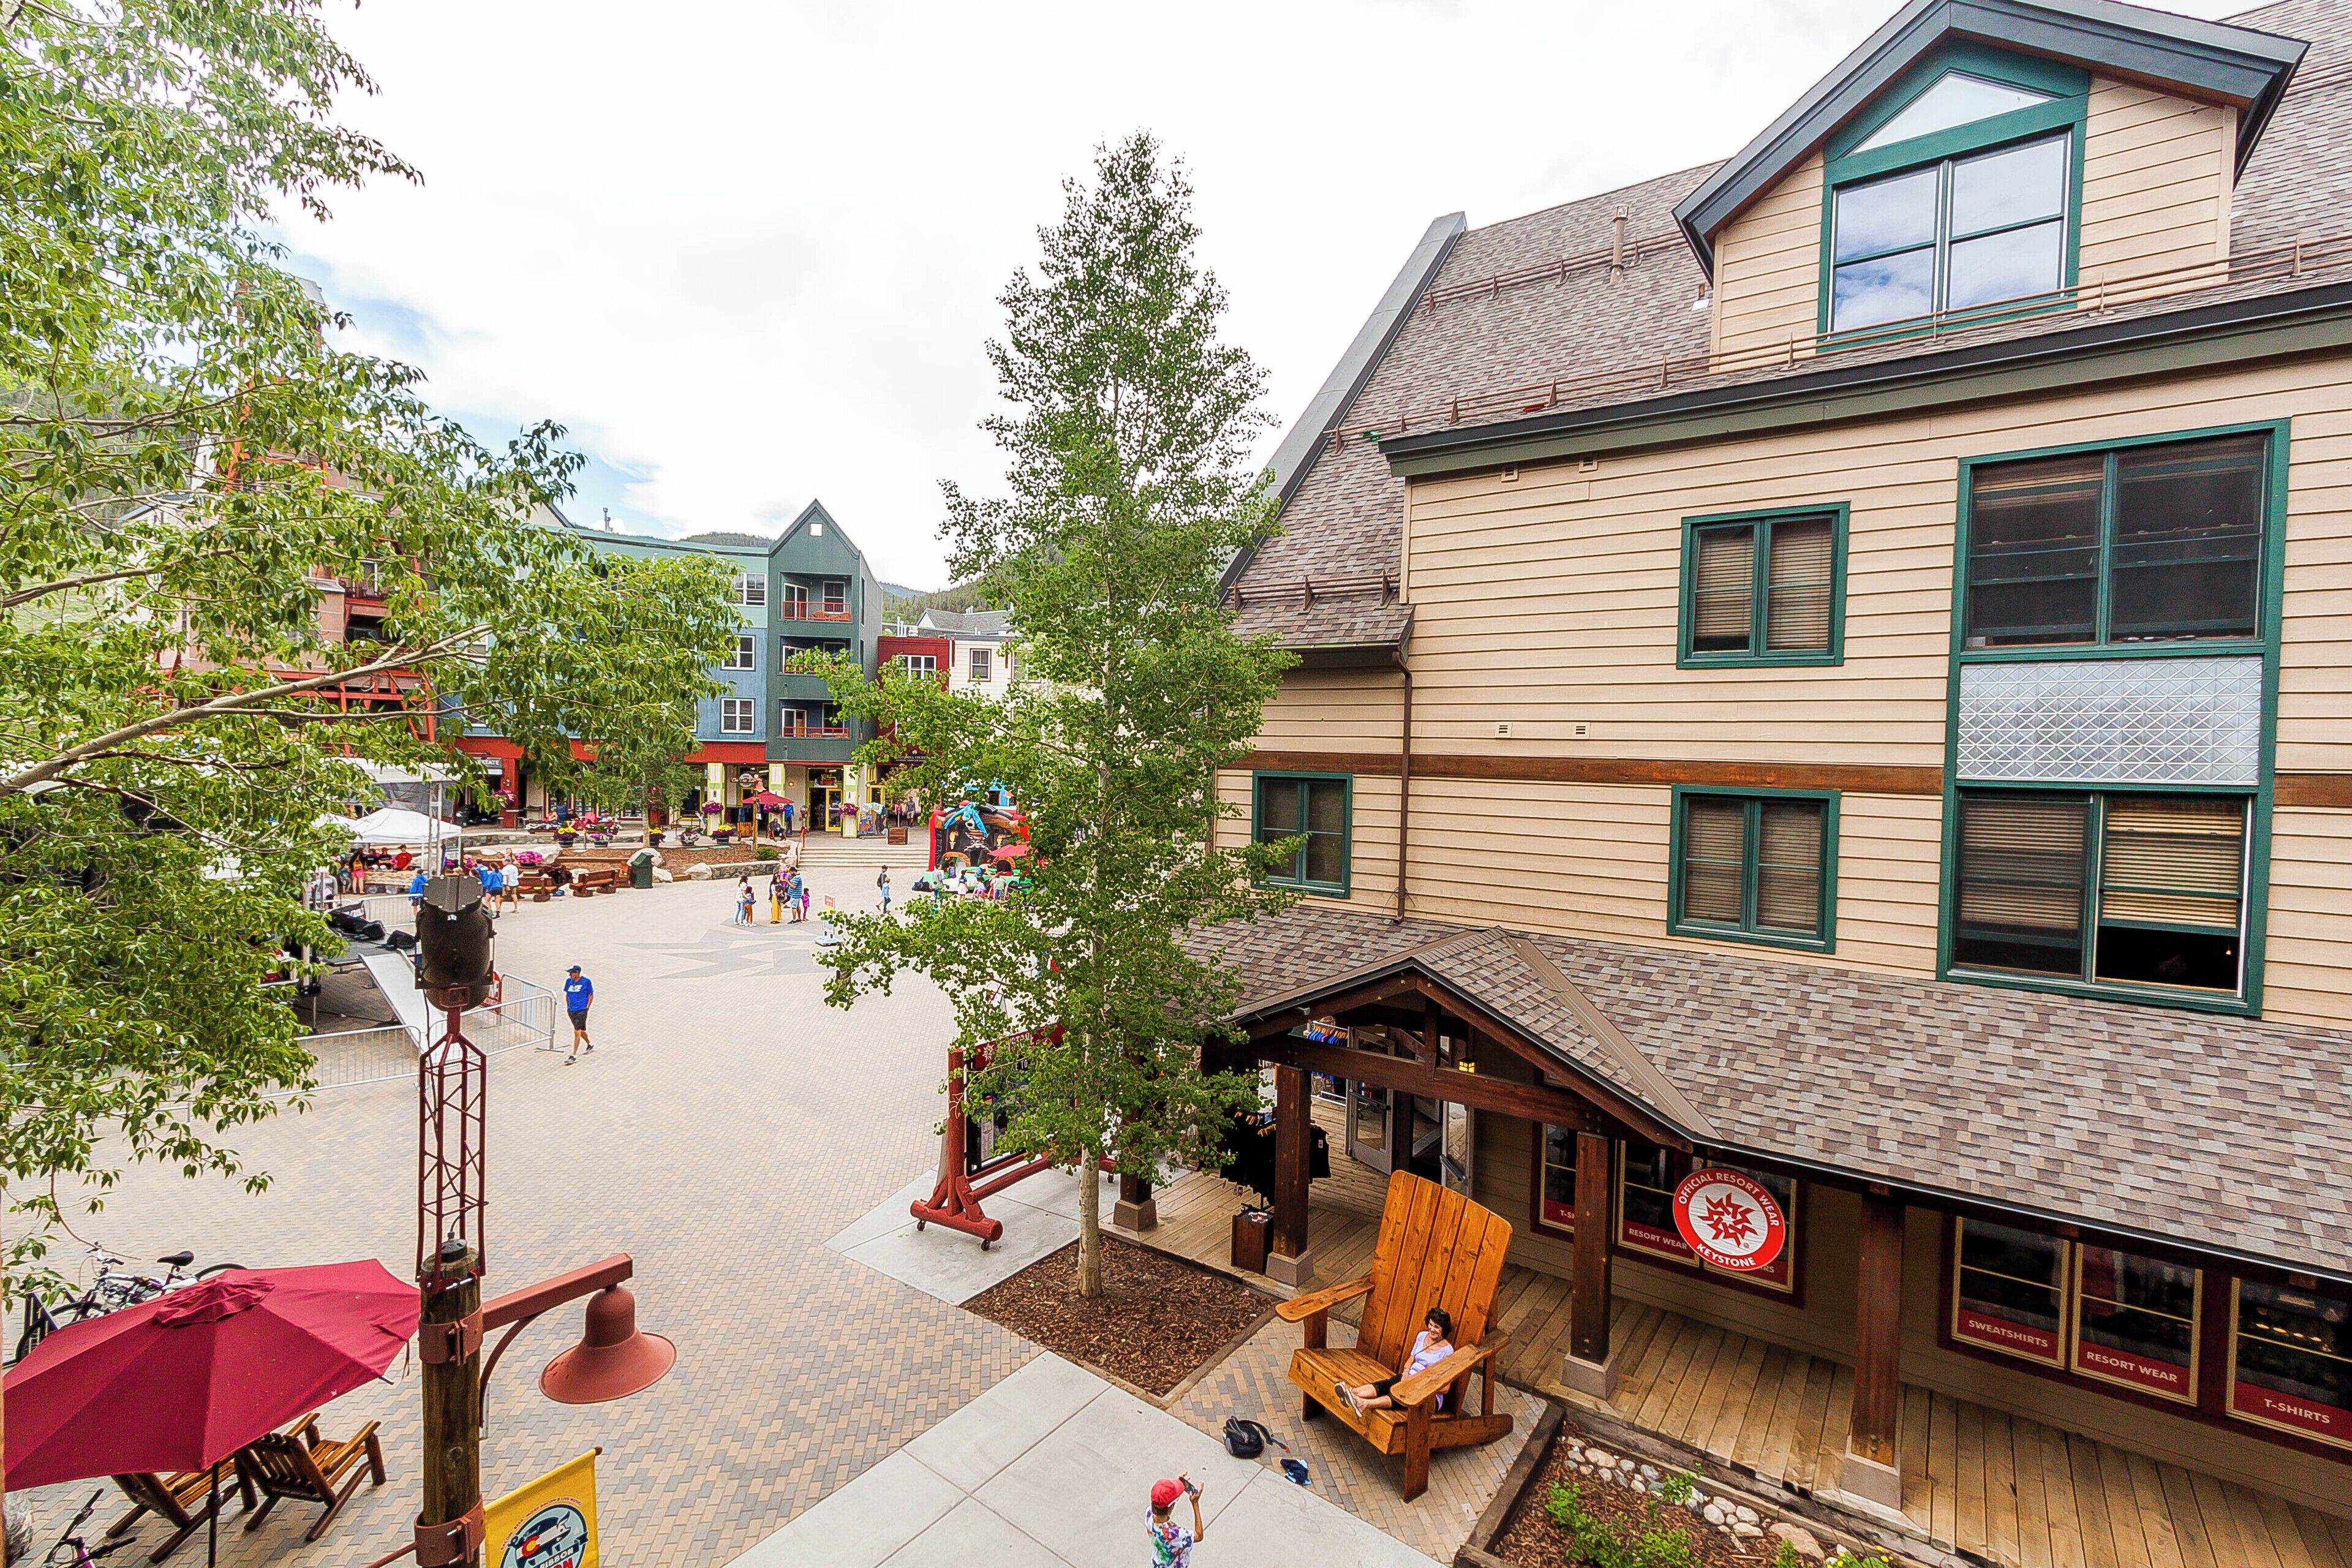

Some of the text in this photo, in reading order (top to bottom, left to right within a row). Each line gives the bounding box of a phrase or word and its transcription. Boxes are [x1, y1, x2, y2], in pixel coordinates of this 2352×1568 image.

[1678, 1172, 1779, 1227] OFFICIAL RESORT WEAR
[1629, 1228, 1687, 1250] RESORT WEAR
[1696, 1243, 1757, 1267] KEYSTONE
[1968, 1319, 2048, 1347] SWEATSHIRTS
[2087, 1351, 2177, 1383] RESORT WEAR
[2264, 1398, 2330, 1424] T-SHIRTS
